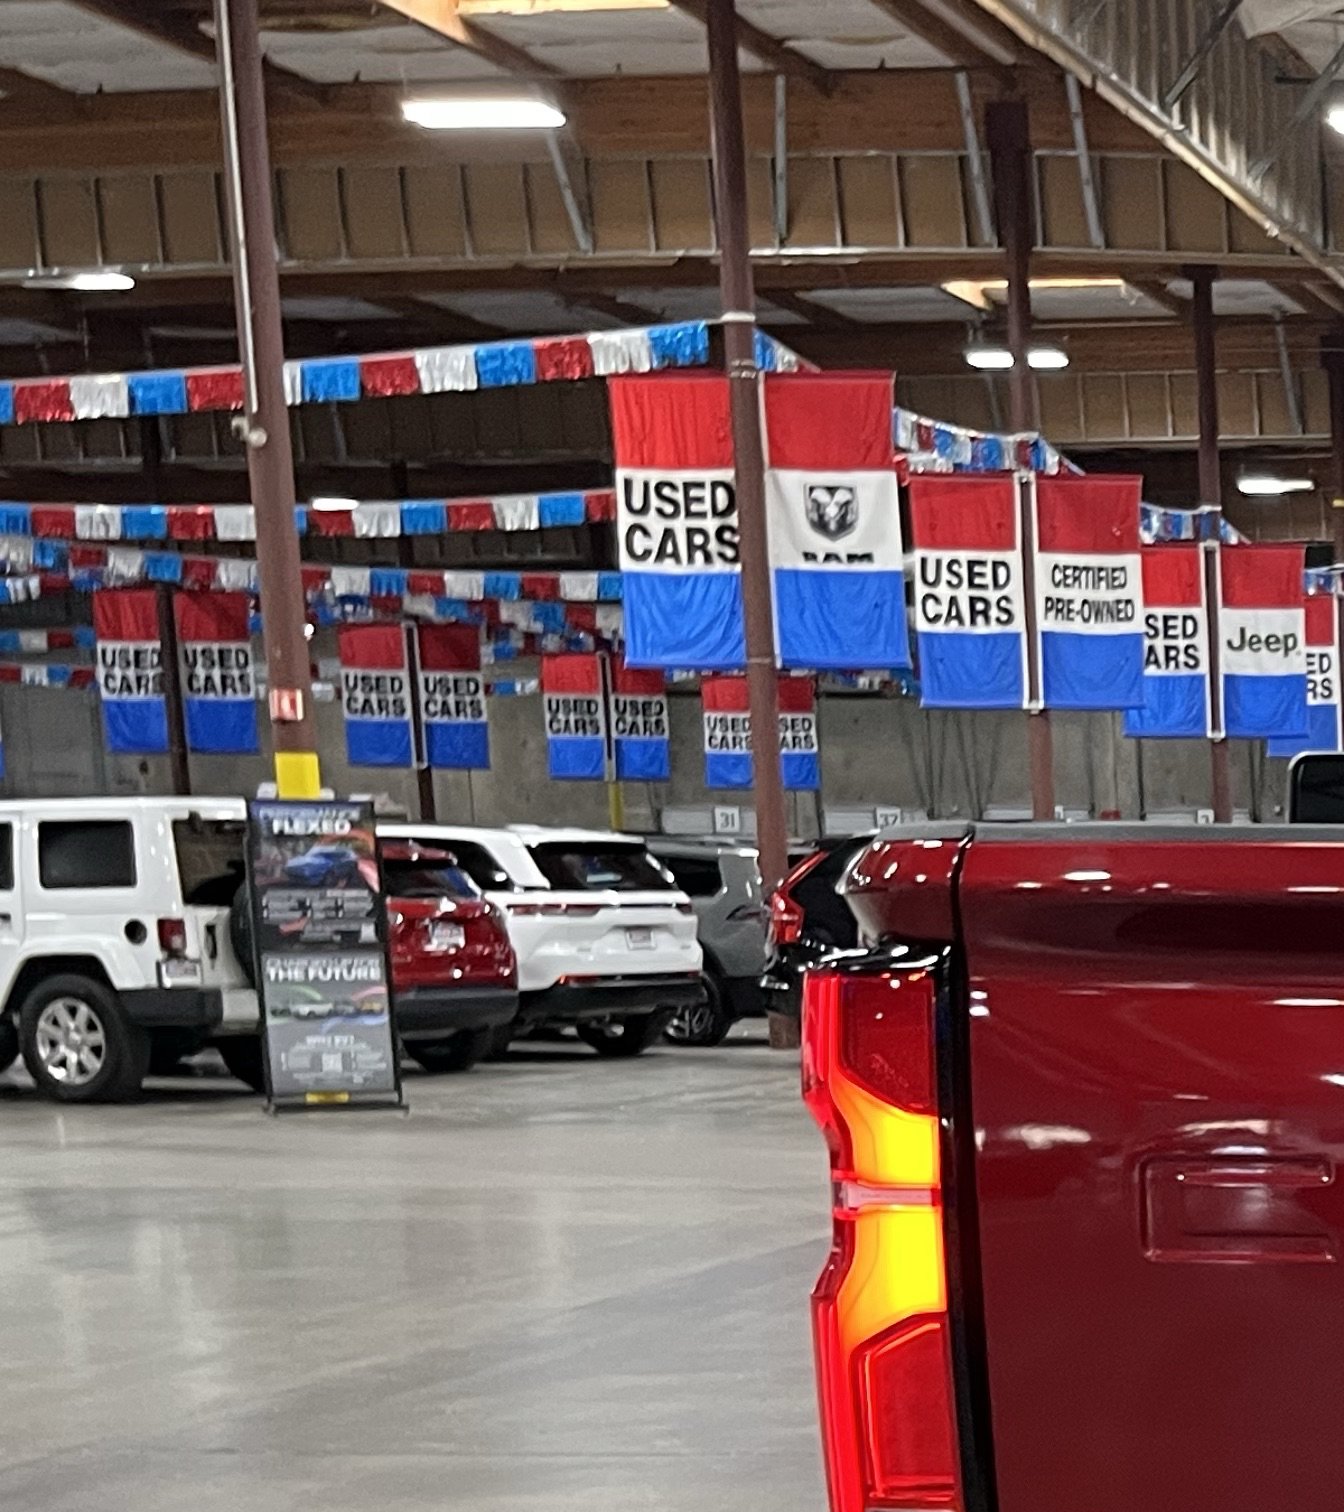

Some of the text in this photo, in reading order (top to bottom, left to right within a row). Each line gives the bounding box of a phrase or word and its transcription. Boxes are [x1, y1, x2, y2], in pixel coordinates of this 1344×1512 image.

[623, 478, 737, 520] USED
[625, 523, 739, 565] CARS
[920, 557, 1011, 591] USED
[1051, 563, 1128, 590] CERTIFIED
[921, 593, 1015, 627] CARS
[1044, 596, 1136, 624] PRE-OWNED
[1144, 614, 1199, 641] SED
[1226, 626, 1298, 658] Jeep
[184, 648, 249, 671] USED
[1144, 644, 1201, 671] ARS
[1306, 652, 1332, 675] ED
[187, 674, 251, 696] CARS
[345, 673, 404, 695] USED
[424, 675, 480, 697] USED
[1308, 678, 1333, 700] RS
[346, 696, 406, 717] CARS
[425, 698, 483, 719] CARS
[547, 698, 599, 716] USED
[614, 698, 665, 717] USED
[549, 717, 600, 736] CARS
[615, 717, 666, 736] CARS
[779, 717, 812, 733] SED
[780, 735, 814, 750] ARS
